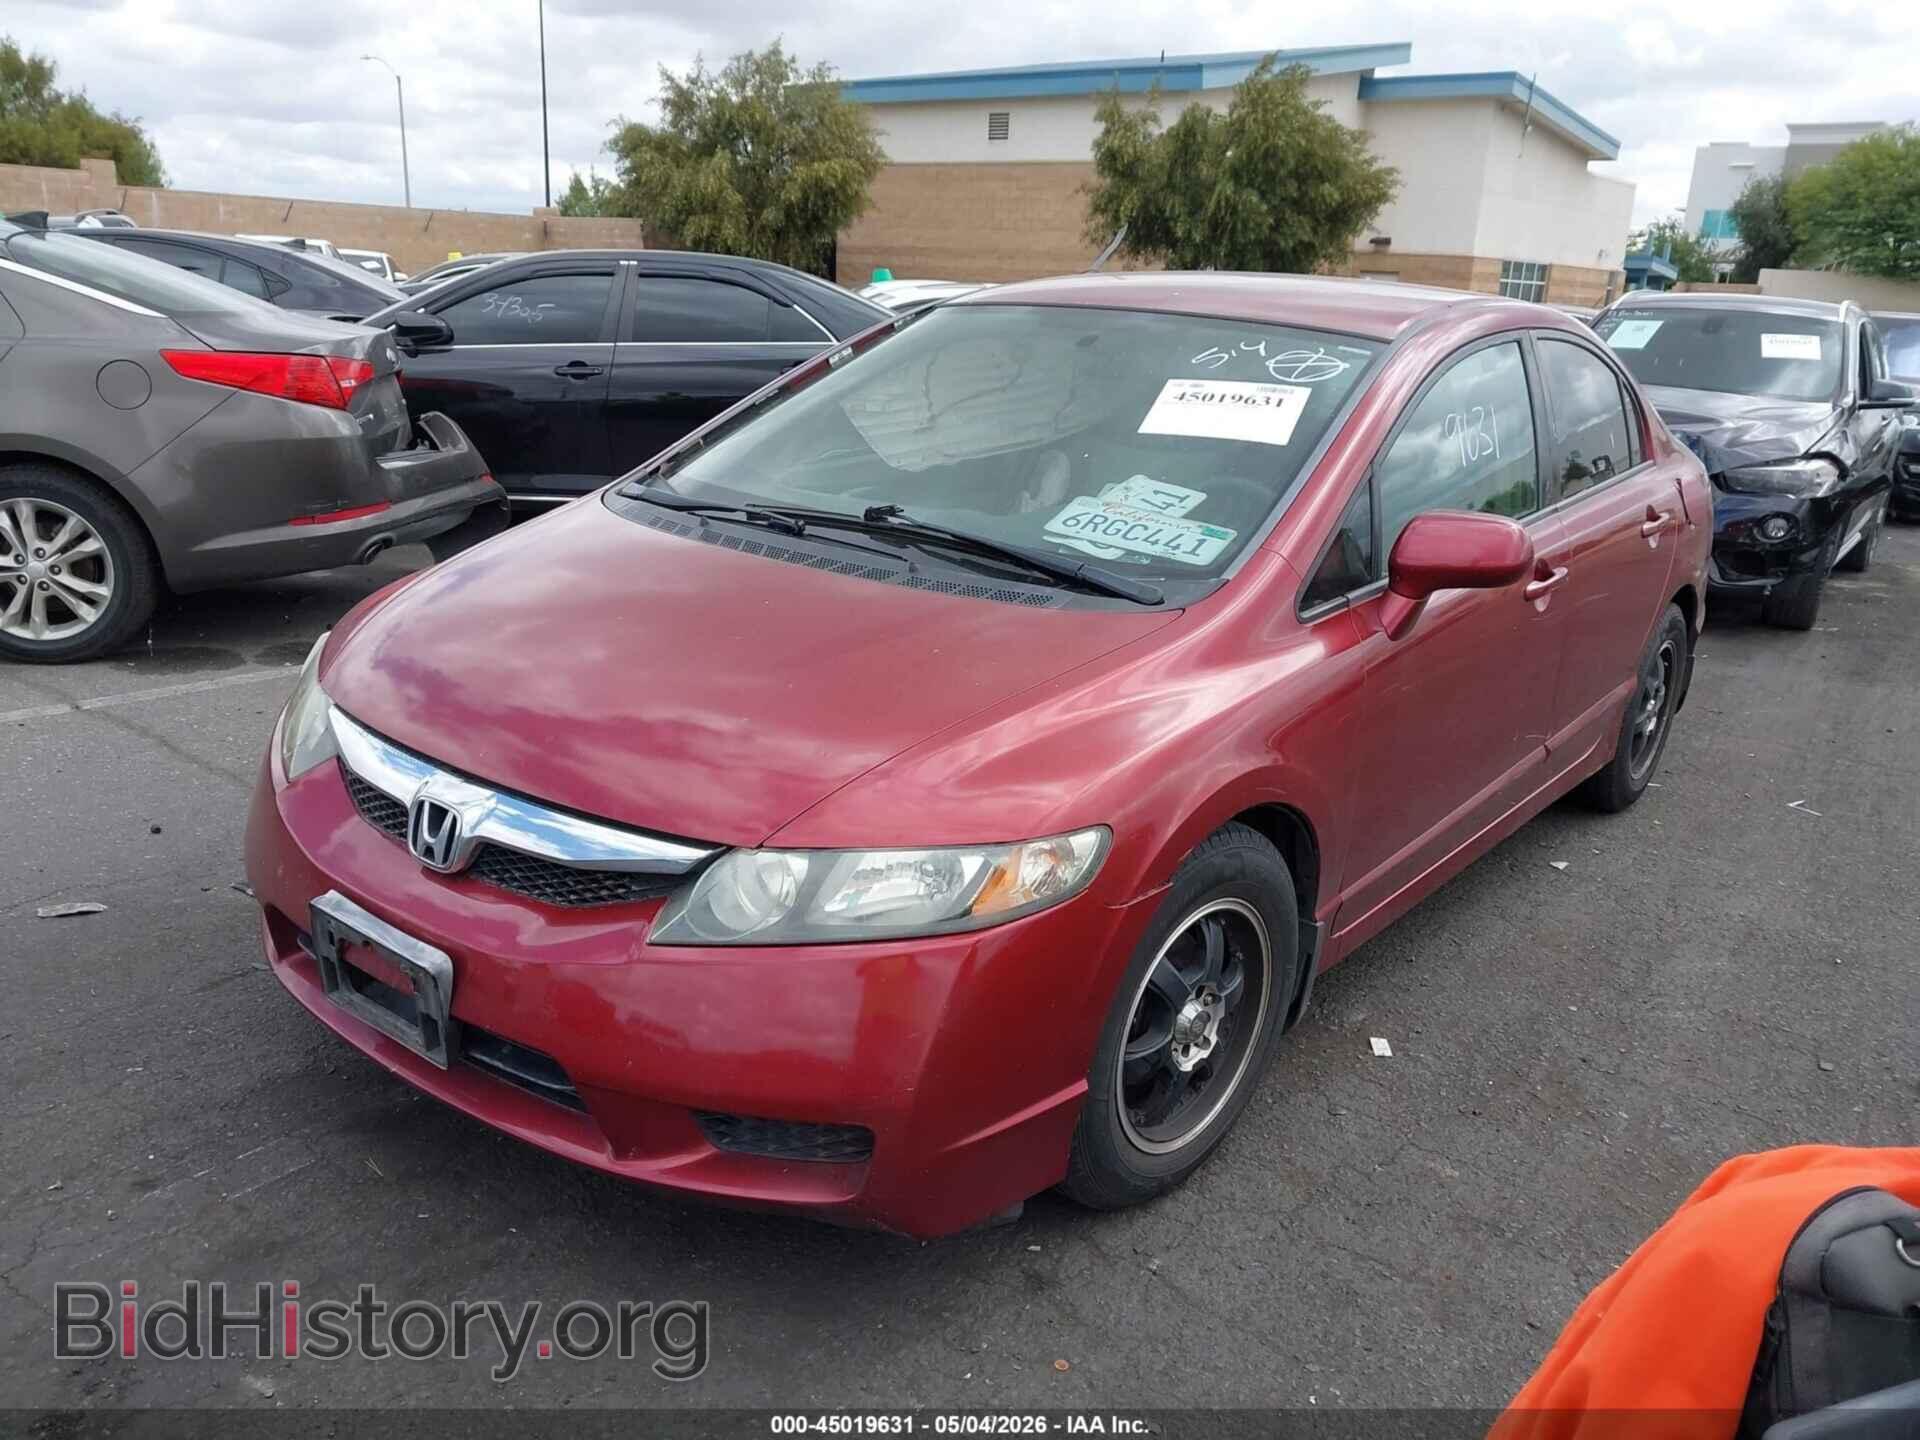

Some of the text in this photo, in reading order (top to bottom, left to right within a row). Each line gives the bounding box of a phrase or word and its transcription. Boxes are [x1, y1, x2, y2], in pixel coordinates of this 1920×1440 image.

[1171, 390, 1285, 408] 45019631
[1444, 405, 1500, 468] 9631
[1061, 512, 1208, 558] 6RGC441
